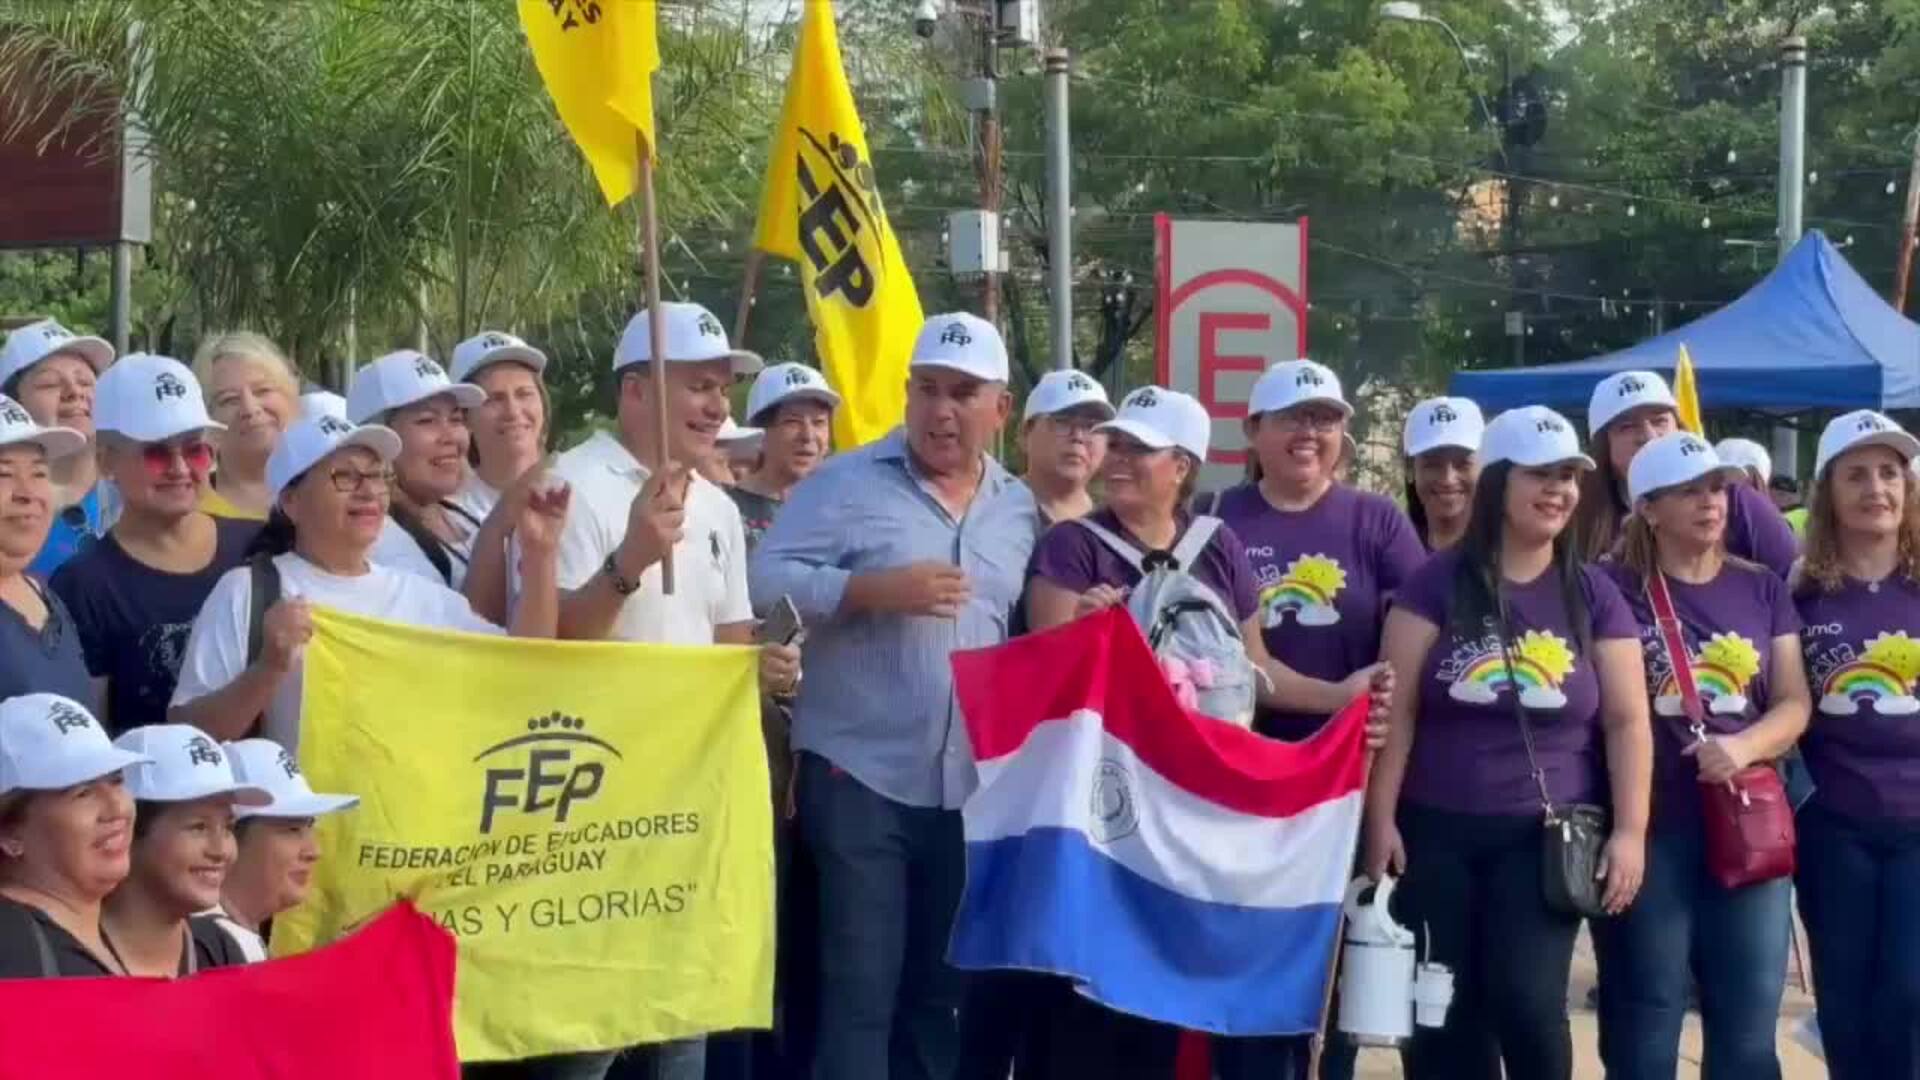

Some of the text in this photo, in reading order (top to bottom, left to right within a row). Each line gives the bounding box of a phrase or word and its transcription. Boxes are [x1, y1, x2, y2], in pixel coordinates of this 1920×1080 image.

[942, 330, 973, 346] FEP
[1199, 312, 1271, 419] E
[156, 382, 186, 400] FEP
[1430, 408, 1457, 425] FEP
[190, 746, 222, 765] FEP
[479, 749, 604, 834] FEP
[505, 834, 537, 855] DE
[485, 848, 607, 883] PARAGUAY
[496, 903, 520, 932] Y
